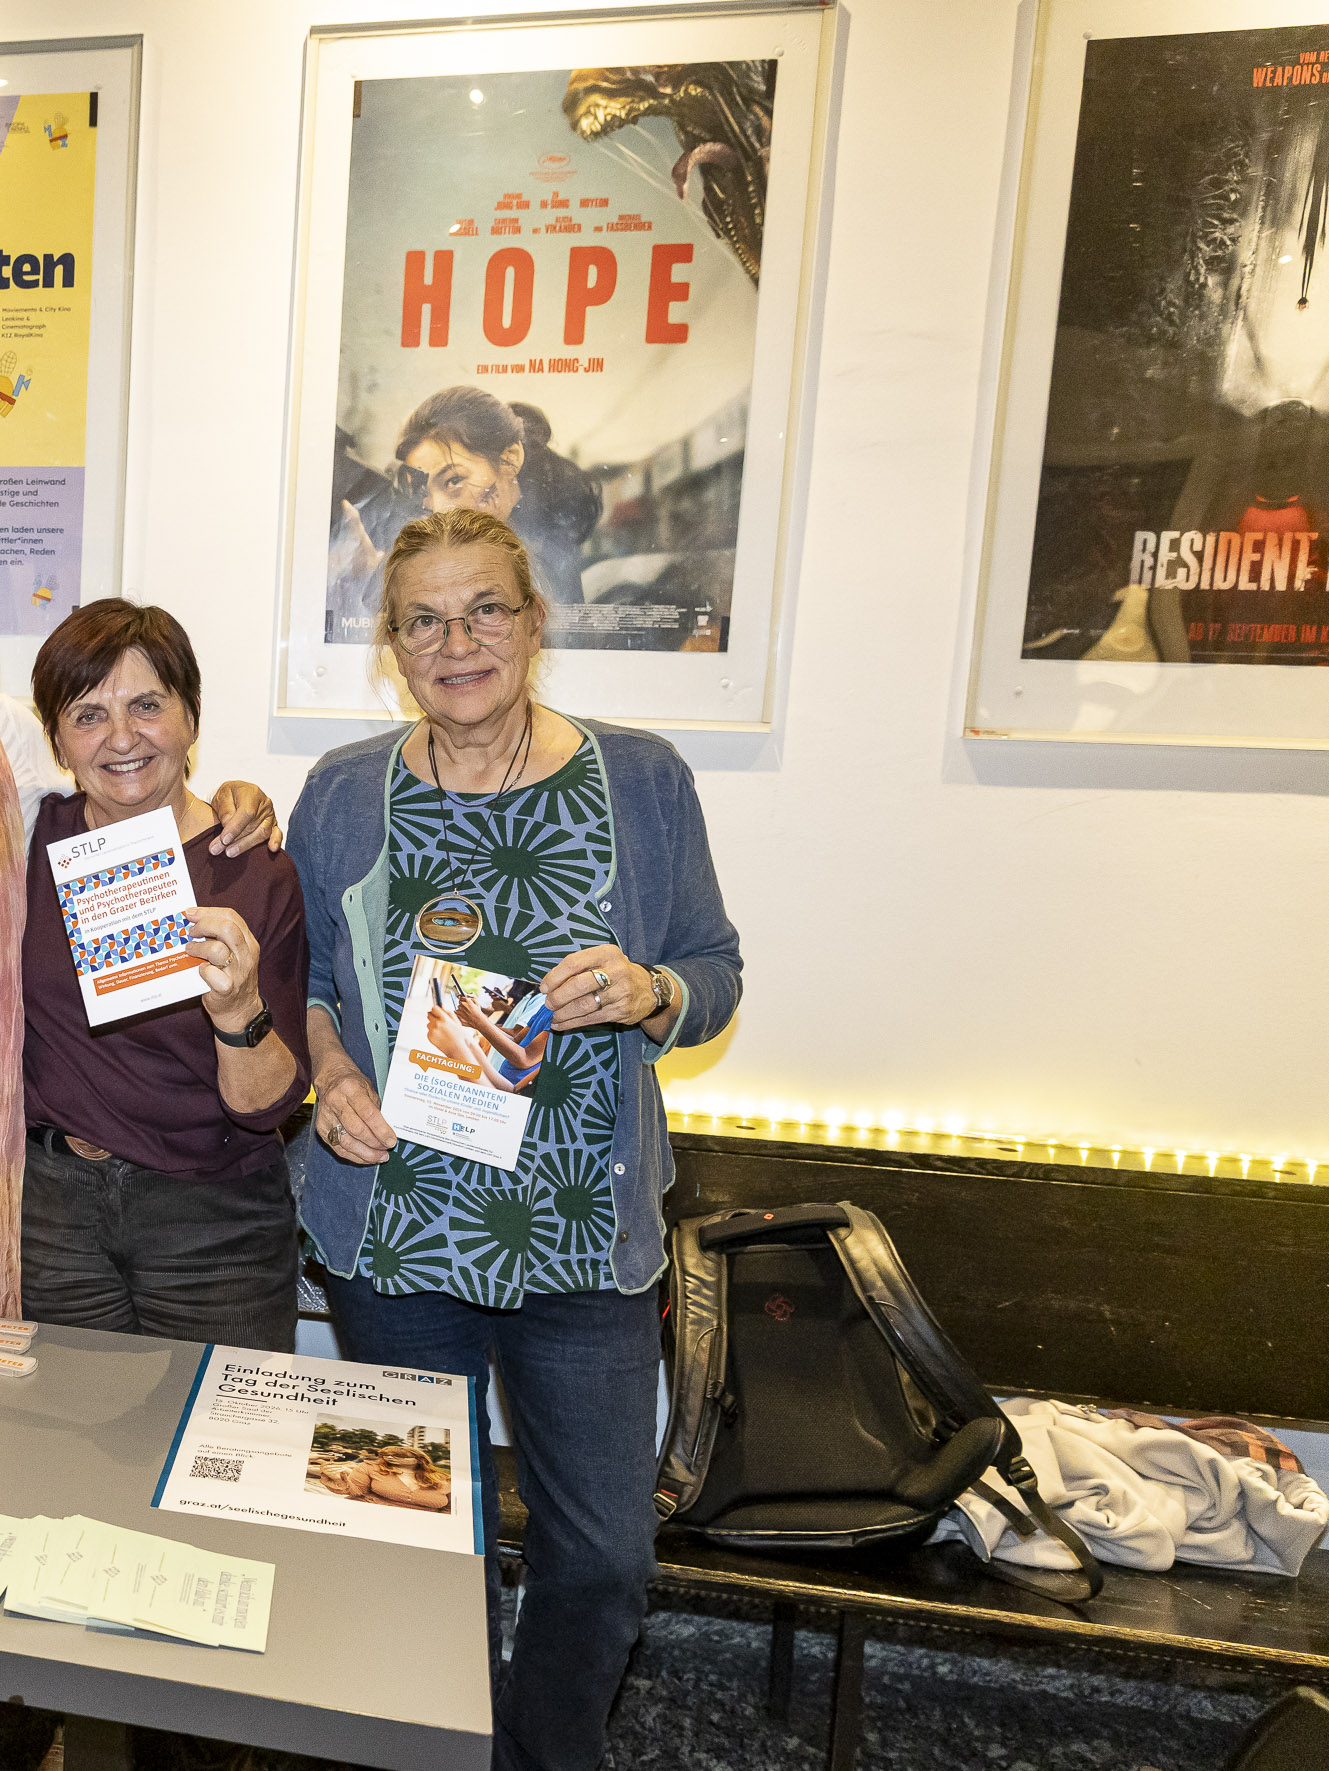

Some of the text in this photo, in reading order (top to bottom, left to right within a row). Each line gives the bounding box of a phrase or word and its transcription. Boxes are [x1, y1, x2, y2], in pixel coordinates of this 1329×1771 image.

[1253, 64, 1321, 87] WEAPONS
[401, 243, 694, 347] HOPE
[477, 358, 604, 374] EIN FILM VON NA HONG-JIN
[1129, 530, 1319, 591] RESIDENT
[1227, 623, 1296, 642] SEPTEMBER
[1300, 624, 1316, 643] IM
[72, 838, 106, 858] STLP
[77, 872, 170, 906] Psychotherapeutinnen
[79, 880, 177, 915] und Psychotherapeuten
[92, 911, 107, 921] den
[110, 902, 137, 915] Grazer
[140, 890, 176, 905] Bezirken
[416, 1053, 474, 1073] FACHTAGUNG:
[414, 1073, 507, 1104] DIE (SOGENANNTEN)
[417, 1083, 499, 1110] SOZIALEN MEDIEN
[222, 1374, 416, 1406] Tag der Seelischen
[225, 1364, 376, 1390] Einladung zum
[383, 1371, 452, 1386] GRAZ
[218, 1384, 338, 1406] Gesundheit
[179, 1499, 346, 1527] graz.at/seelischegesundheit
